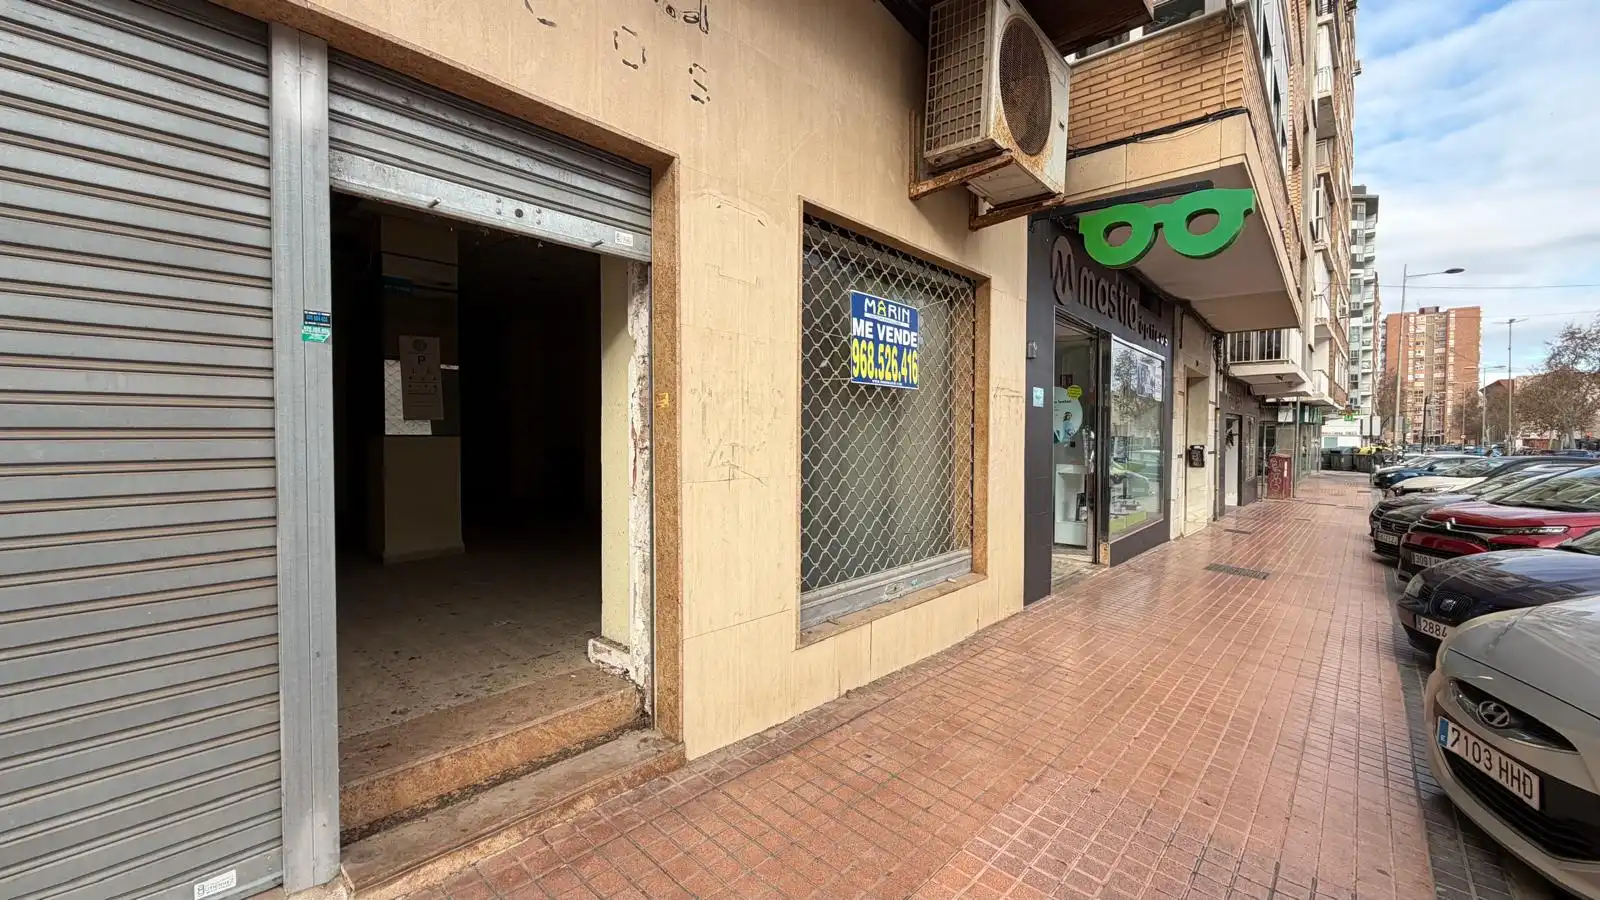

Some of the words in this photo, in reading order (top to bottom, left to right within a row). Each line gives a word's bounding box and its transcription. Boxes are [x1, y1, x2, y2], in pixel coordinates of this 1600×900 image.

[864, 298, 910, 323] MARIN
[852, 317, 874, 339] ME
[877, 323, 918, 347] VENDE
[852, 338, 918, 384] 968.526.416
[1422, 619, 1448, 638] 2884
[1449, 727, 1493, 772] 7103
[1499, 754, 1534, 800] HHD
